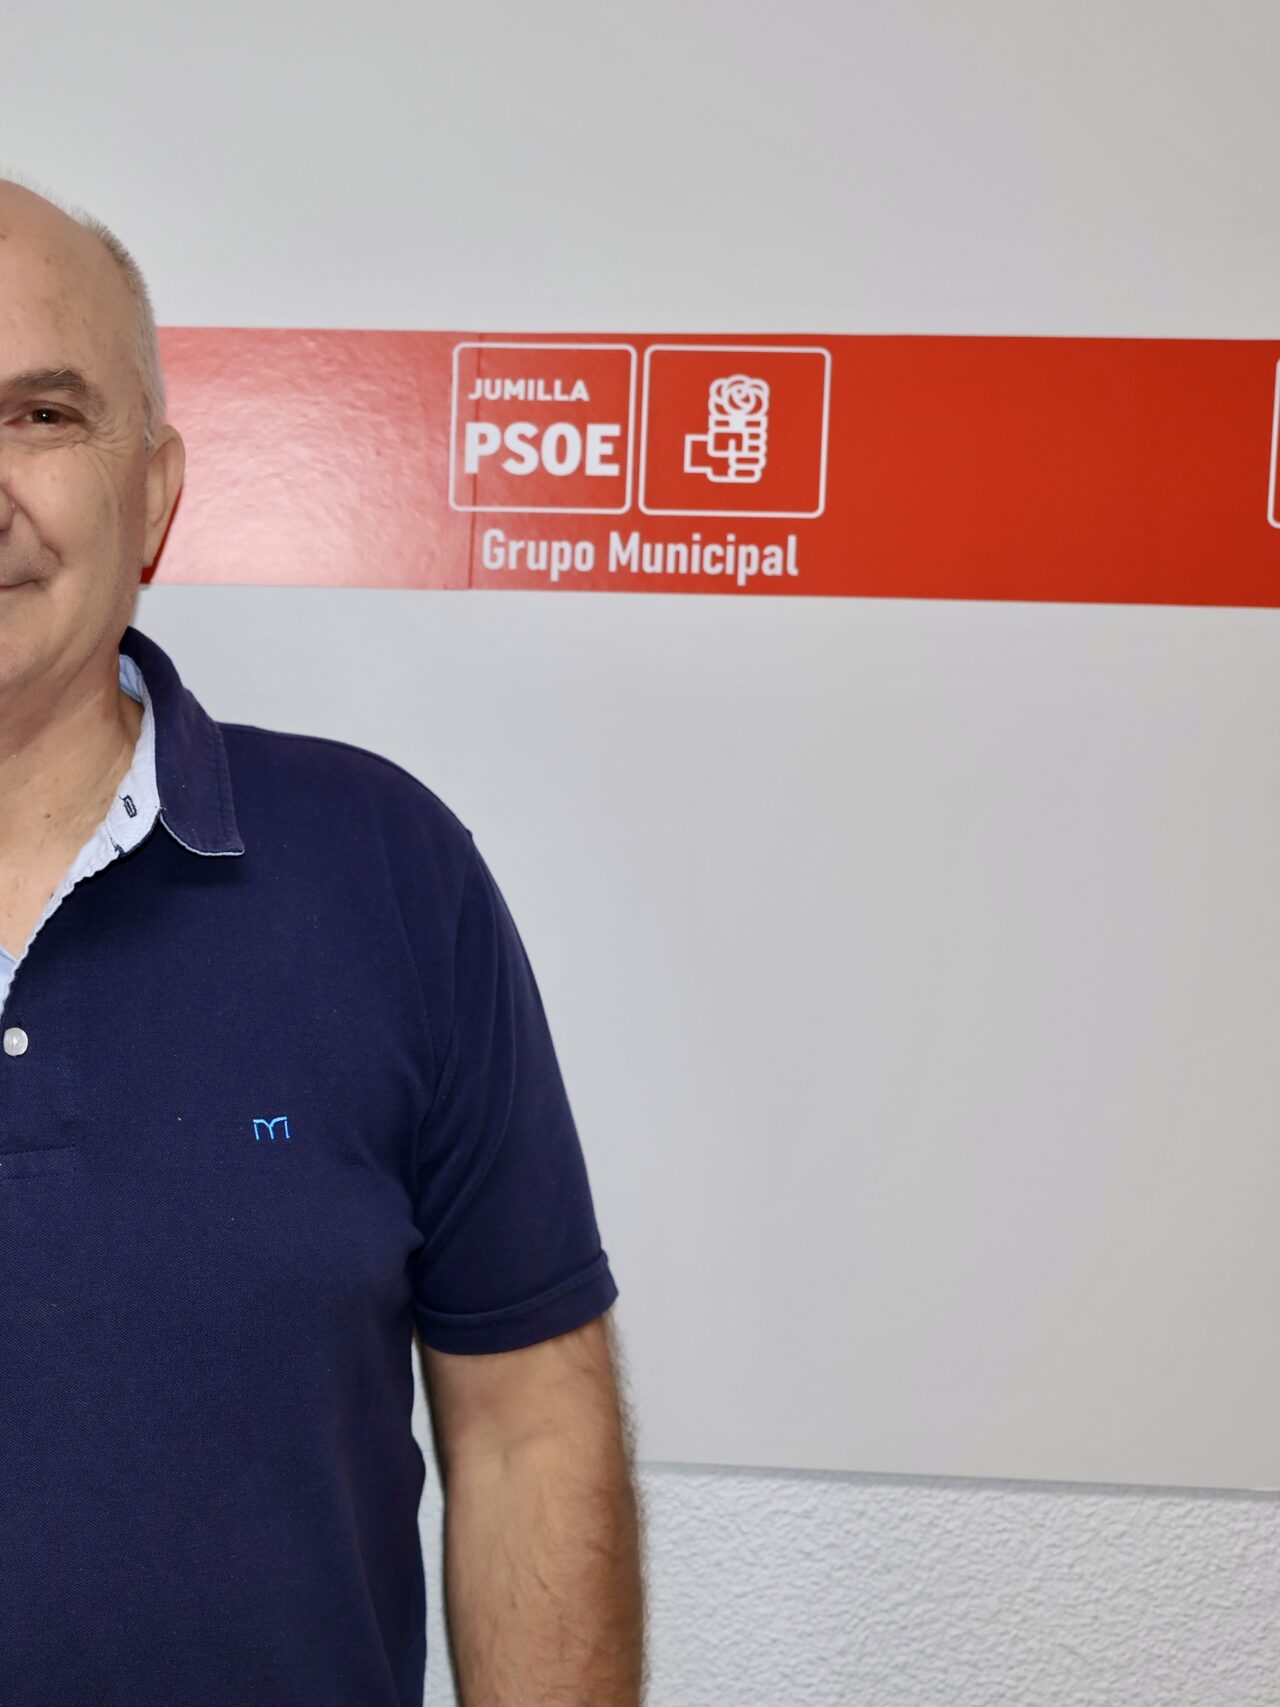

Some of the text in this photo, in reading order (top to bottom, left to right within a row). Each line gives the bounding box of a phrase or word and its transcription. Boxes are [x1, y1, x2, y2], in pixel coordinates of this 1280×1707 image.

[468, 378, 590, 402] JUMILLA
[463, 421, 621, 477] PSOE
[481, 528, 799, 586] Grupo Municipal
